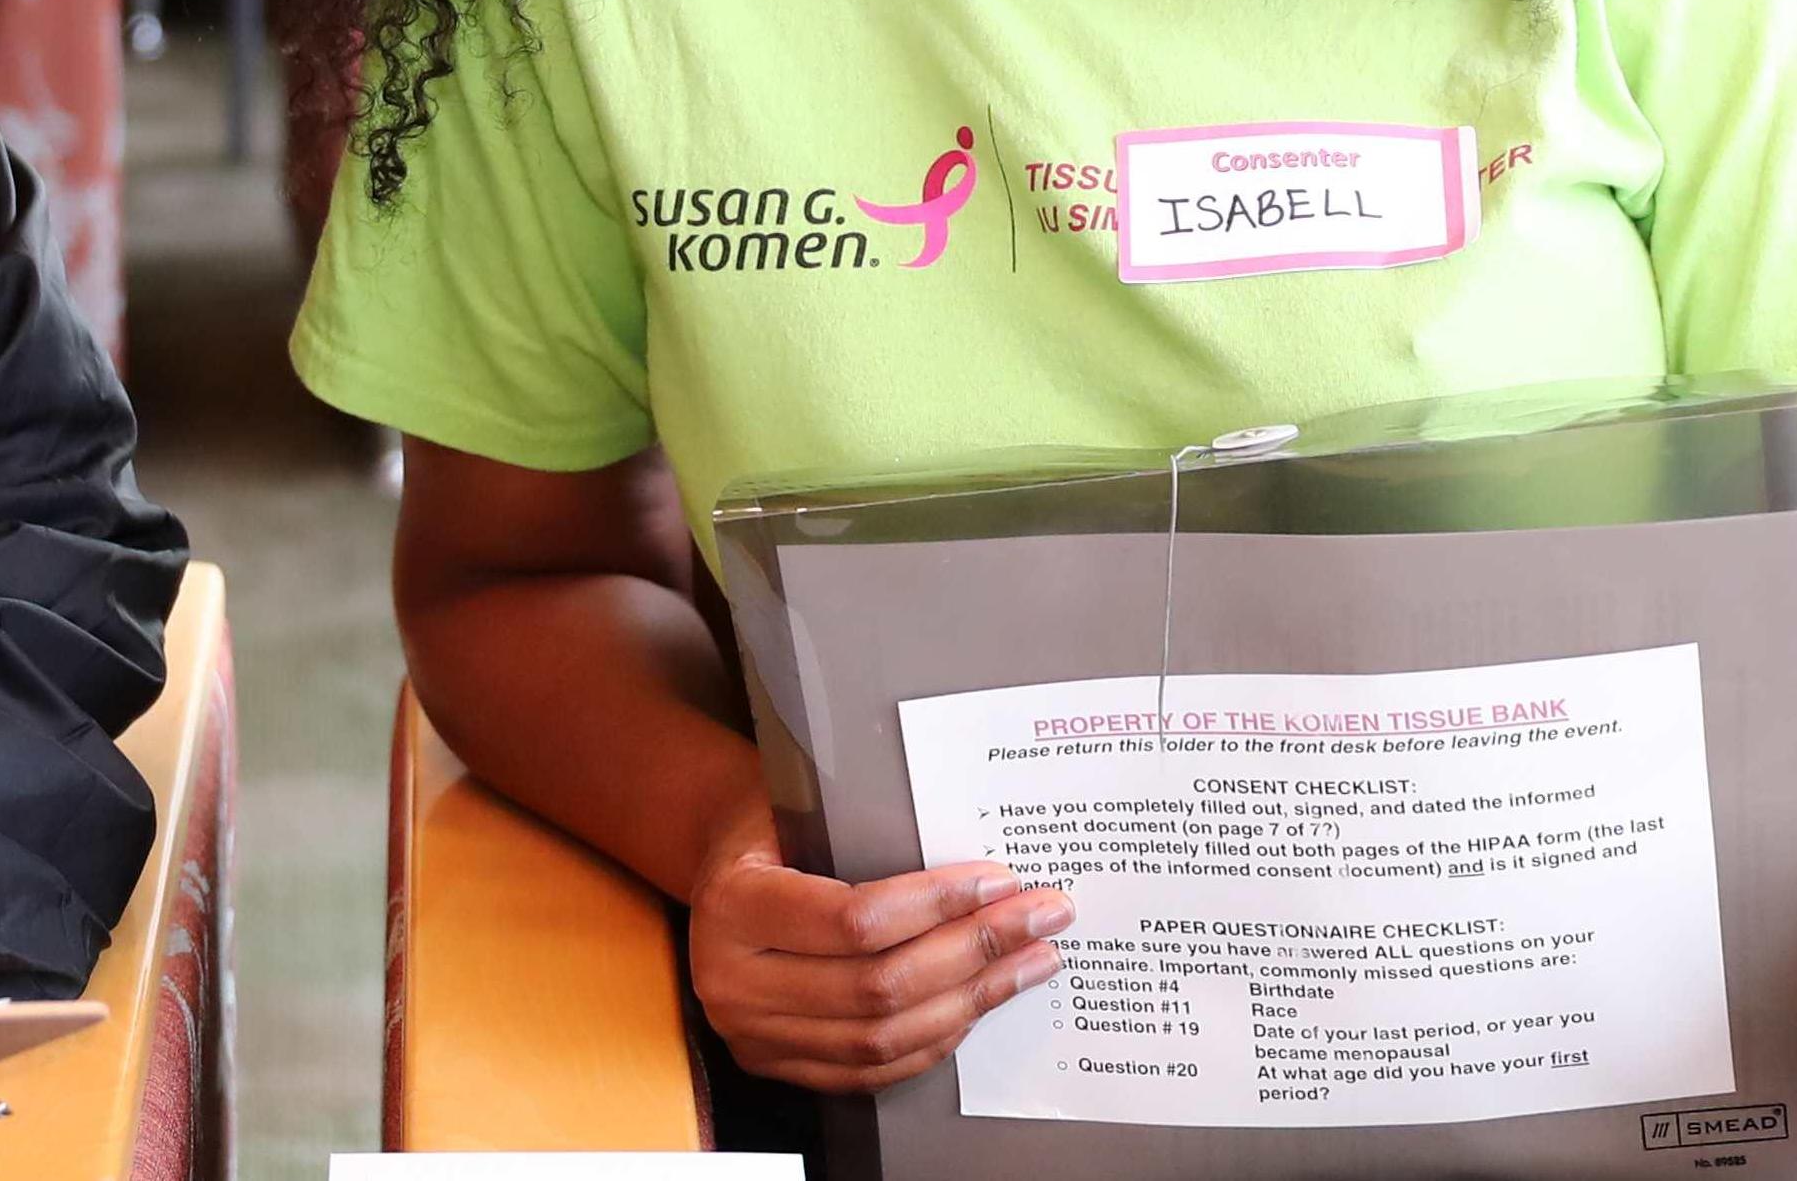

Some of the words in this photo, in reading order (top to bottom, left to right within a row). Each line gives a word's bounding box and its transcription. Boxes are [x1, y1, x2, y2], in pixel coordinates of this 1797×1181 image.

[1212, 149, 1361, 172] Consenter
[1159, 189, 1382, 235] ISABELL
[1034, 712, 1172, 737] PROPERTY
[1183, 712, 1217, 730] OF
[1224, 712, 1276, 731] THE
[1285, 713, 1380, 732] KOMEN
[1388, 707, 1484, 731] TISSUE
[1492, 698, 1568, 723] BANK
[988, 745, 1050, 761] Please
[1056, 740, 1112, 755] return
[1119, 737, 1153, 752] this
[1163, 737, 1215, 752] older
[1221, 738, 1238, 752] to
[1245, 738, 1273, 752] the
[1280, 739, 1325, 754] front
[1331, 738, 1376, 754] desk
[1382, 737, 1444, 753] before
[1452, 731, 1521, 748] leaving
[1529, 728, 1558, 742] the
[1564, 720, 1622, 739] event.
[1193, 779, 1288, 795] CONSENT
[1295, 780, 1417, 795] CHECKLIST:
[1000, 803, 1046, 817] Have
[1053, 802, 1086, 819] you
[1093, 799, 1194, 816] completely
[1201, 800, 1245, 815] filled
[1252, 802, 1288, 817] out,
[1294, 802, 1364, 819] signed,
[1370, 801, 1405, 815] and
[1412, 799, 1466, 814] dated
[1472, 797, 1502, 811] the
[1509, 784, 1595, 807] informed
[1003, 821, 1077, 836] consent
[1084, 818, 1176, 834] document
[1183, 821, 1212, 836] (on
[1218, 823, 1263, 839] page
[1269, 823, 1279, 835] 7
[1286, 822, 1303, 837] of
[1310, 822, 1341, 839] 7?)
[1006, 842, 1052, 856] Have
[1058, 841, 1092, 858] you
[1099, 839, 1199, 857] completely
[1205, 842, 1250, 856] filled
[1256, 843, 1286, 857] out
[1293, 843, 1335, 858] both
[1343, 842, 1399, 860] pages
[1406, 841, 1424, 855] of
[1430, 840, 1460, 855] the
[1468, 834, 1530, 853] HIPAA
[1537, 829, 1581, 846] form
[1588, 822, 1624, 841] (the
[1631, 816, 1665, 834] last
[1049, 860, 1103, 876] pages
[1110, 859, 1127, 872] of
[1133, 860, 1161, 873] the
[1168, 861, 1250, 876] informed
[1256, 861, 1333, 878] consent
[1339, 862, 1442, 879] document)
[1448, 858, 1484, 878] and
[1491, 857, 1505, 872] is
[1513, 856, 1525, 870] it
[1532, 847, 1595, 869] signed
[1603, 841, 1637, 859] and
[1140, 920, 1206, 935] PAPER
[1212, 921, 1376, 940] QUESTIONNAIRE
[1383, 918, 1505, 939] CHECKLIST:
[1087, 938, 1135, 952] make
[1142, 941, 1181, 953] sure
[1188, 942, 1221, 956] you
[1227, 942, 1271, 956] have
[1375, 945, 1413, 959] ALL
[1419, 938, 1514, 959] questions
[1520, 936, 1544, 949] on
[1551, 930, 1595, 949] your
[1160, 960, 1254, 978] Important,
[1260, 965, 1356, 982] commonly
[1364, 964, 1432, 980] missed
[1440, 954, 1535, 978] questions
[1540, 952, 1576, 968] are:
[1070, 976, 1152, 992] Question
[1159, 978, 1180, 993] #4
[1249, 982, 1335, 1000] Birthdate
[1073, 996, 1155, 1014] Question
[1161, 1000, 1190, 1015] #11
[1252, 1003, 1298, 1019] Race
[1075, 1016, 1156, 1034] Question
[1162, 1022, 1172, 1034] #
[1179, 1021, 1199, 1035] 19
[1253, 1024, 1295, 1039] Date
[1301, 1026, 1318, 1039] of
[1325, 1027, 1367, 1044] your
[1373, 1026, 1408, 1040] last
[1414, 1021, 1482, 1041] period,
[1486, 1019, 1505, 1032] or
[1512, 1014, 1553, 1036] year
[1560, 1010, 1595, 1027] you
[1255, 1044, 1327, 1060] became
[1333, 1044, 1450, 1062] menopausal
[1078, 1057, 1160, 1076] Question
[1167, 1062, 1198, 1077] #20
[1257, 1066, 1277, 1080] At
[1283, 1066, 1326, 1081] what
[1333, 1069, 1367, 1084] age
[1373, 1064, 1403, 1080] did
[1410, 1066, 1445, 1082] you
[1451, 1060, 1495, 1077] have
[1502, 1054, 1545, 1074] your
[1550, 1049, 1590, 1069] first
[1258, 1086, 1330, 1103] period?
